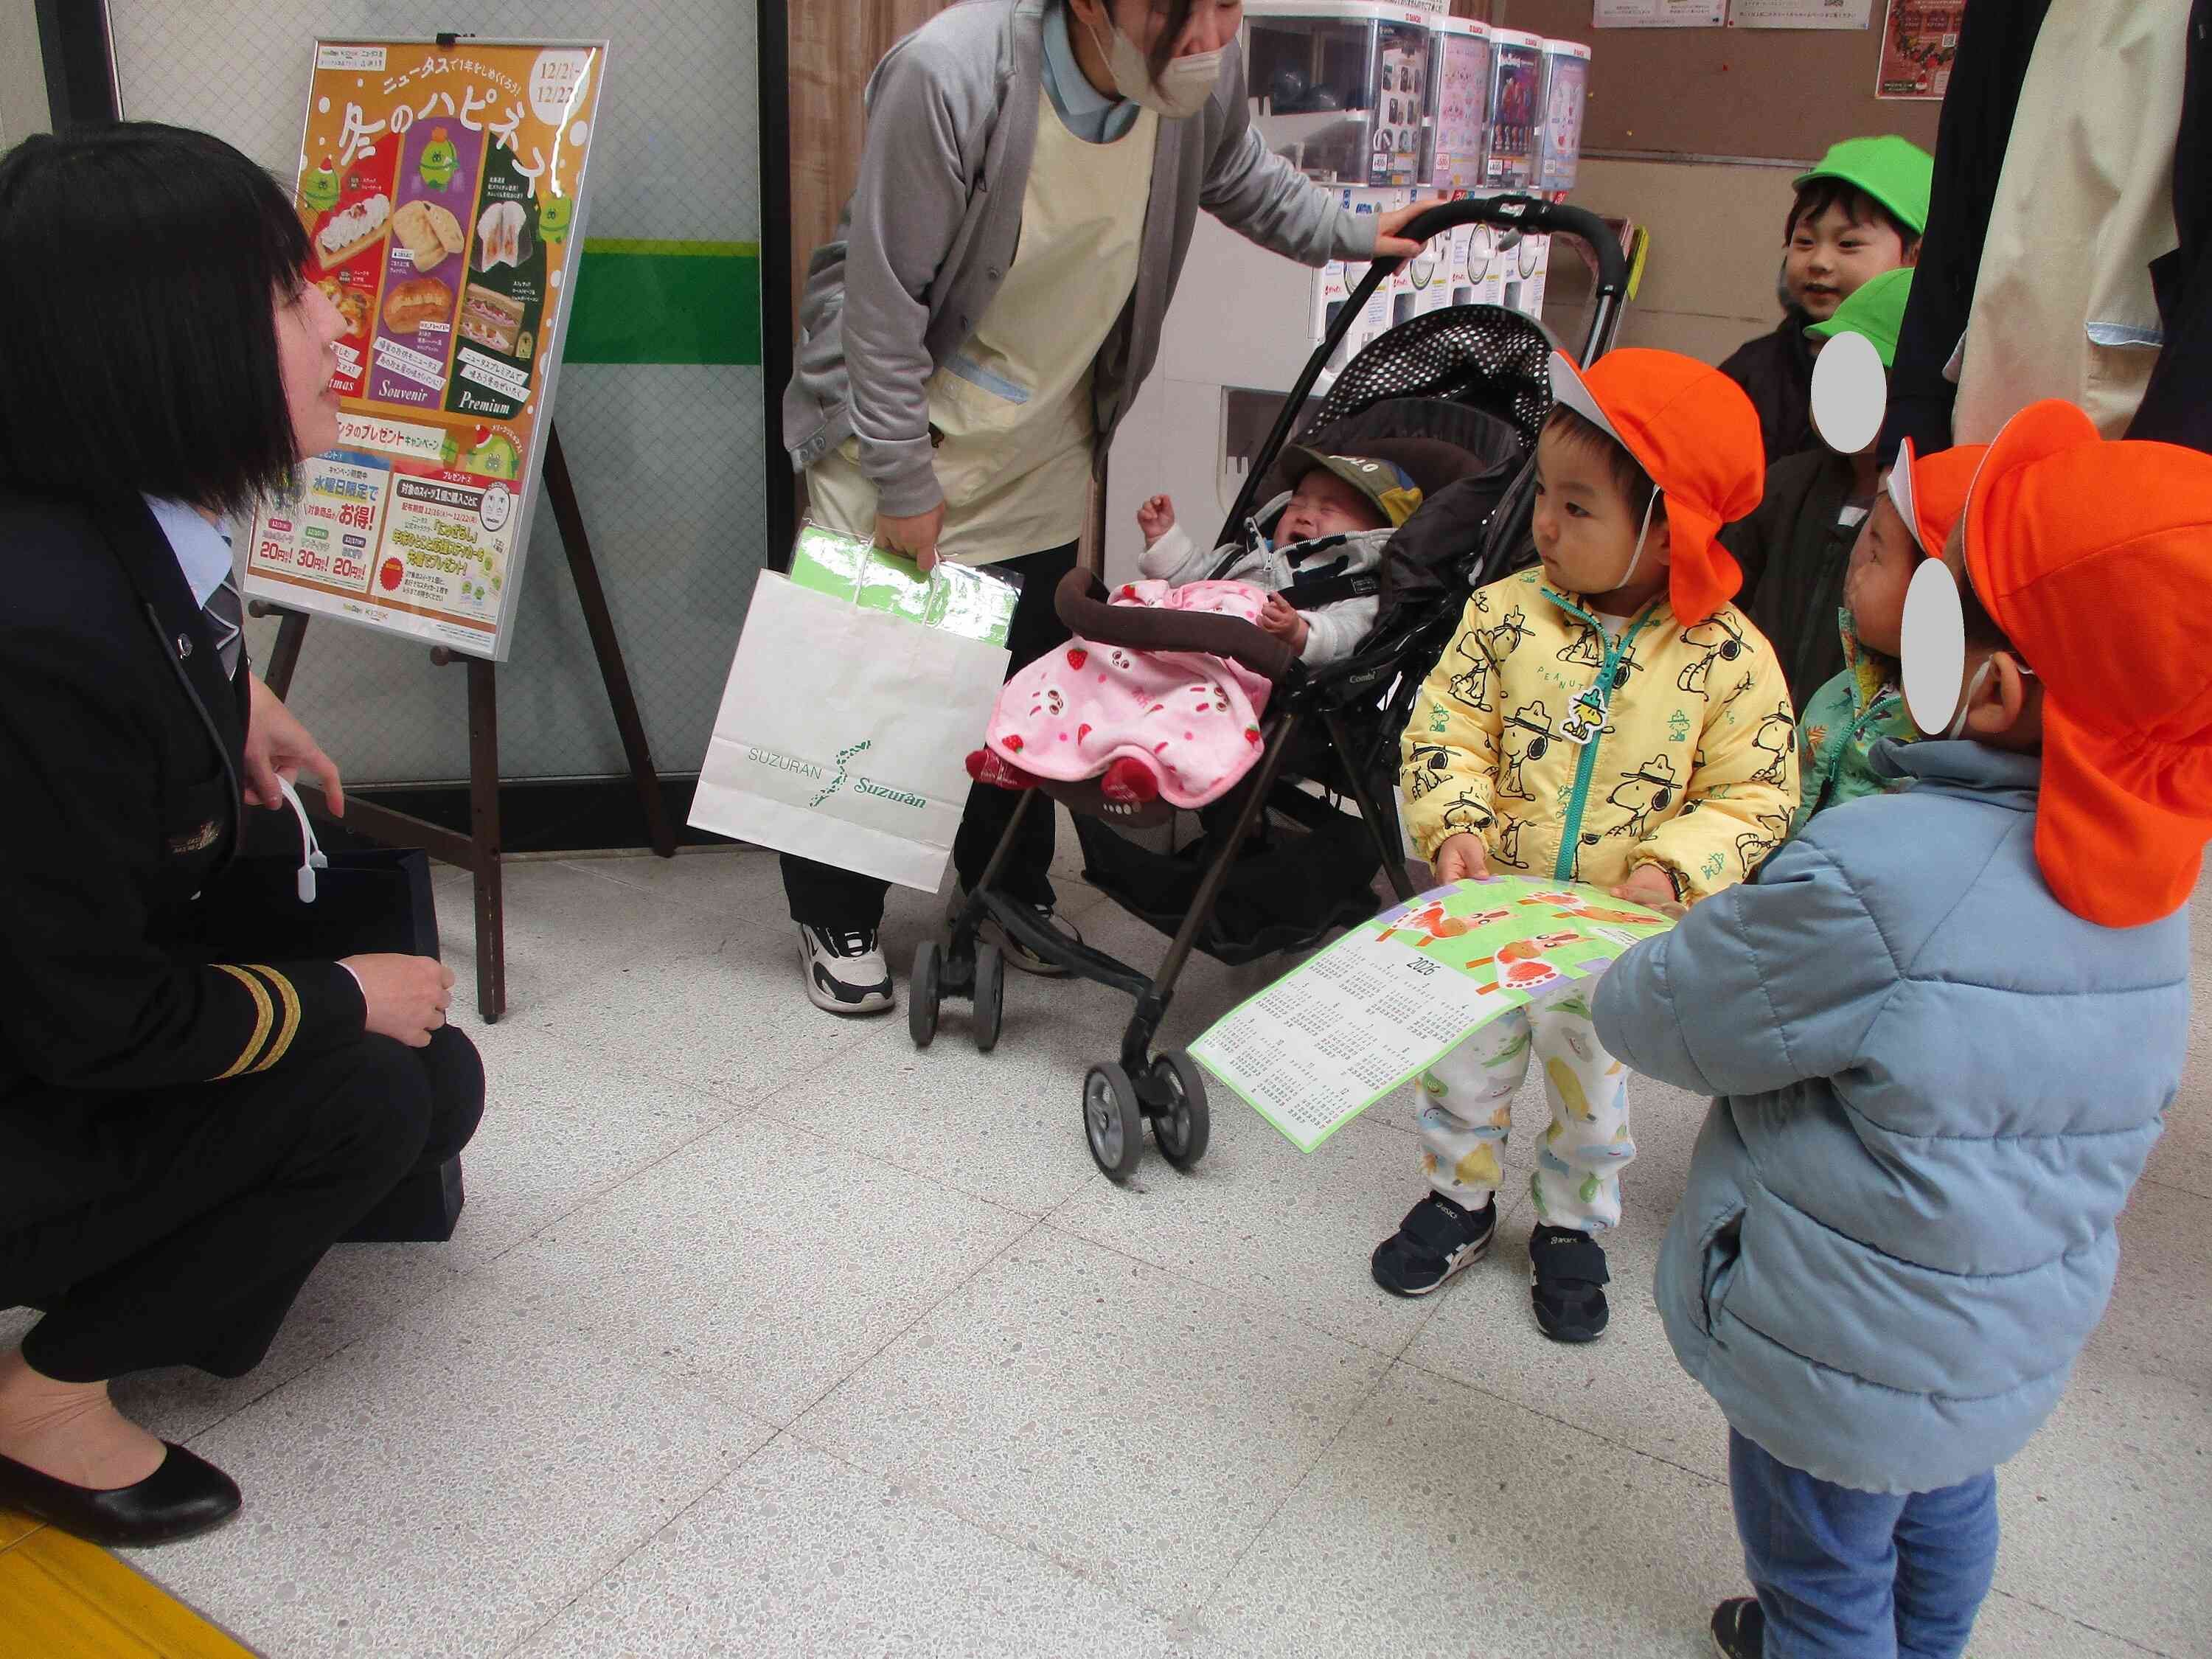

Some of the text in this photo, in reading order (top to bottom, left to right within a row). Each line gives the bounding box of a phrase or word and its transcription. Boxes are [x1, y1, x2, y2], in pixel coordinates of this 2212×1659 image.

[329, 377, 354, 392] tmas
[379, 379, 428, 403] Souvenir
[458, 390, 510, 414] Premium
[337, 420, 439, 451] ンタのプレゼントキャンペーン
[313, 475, 379, 501] 水曜日限定で
[1349, 670, 1376, 684] Combi
[748, 747, 822, 780] SUZURAN
[1406, 956, 1441, 976] 2026
